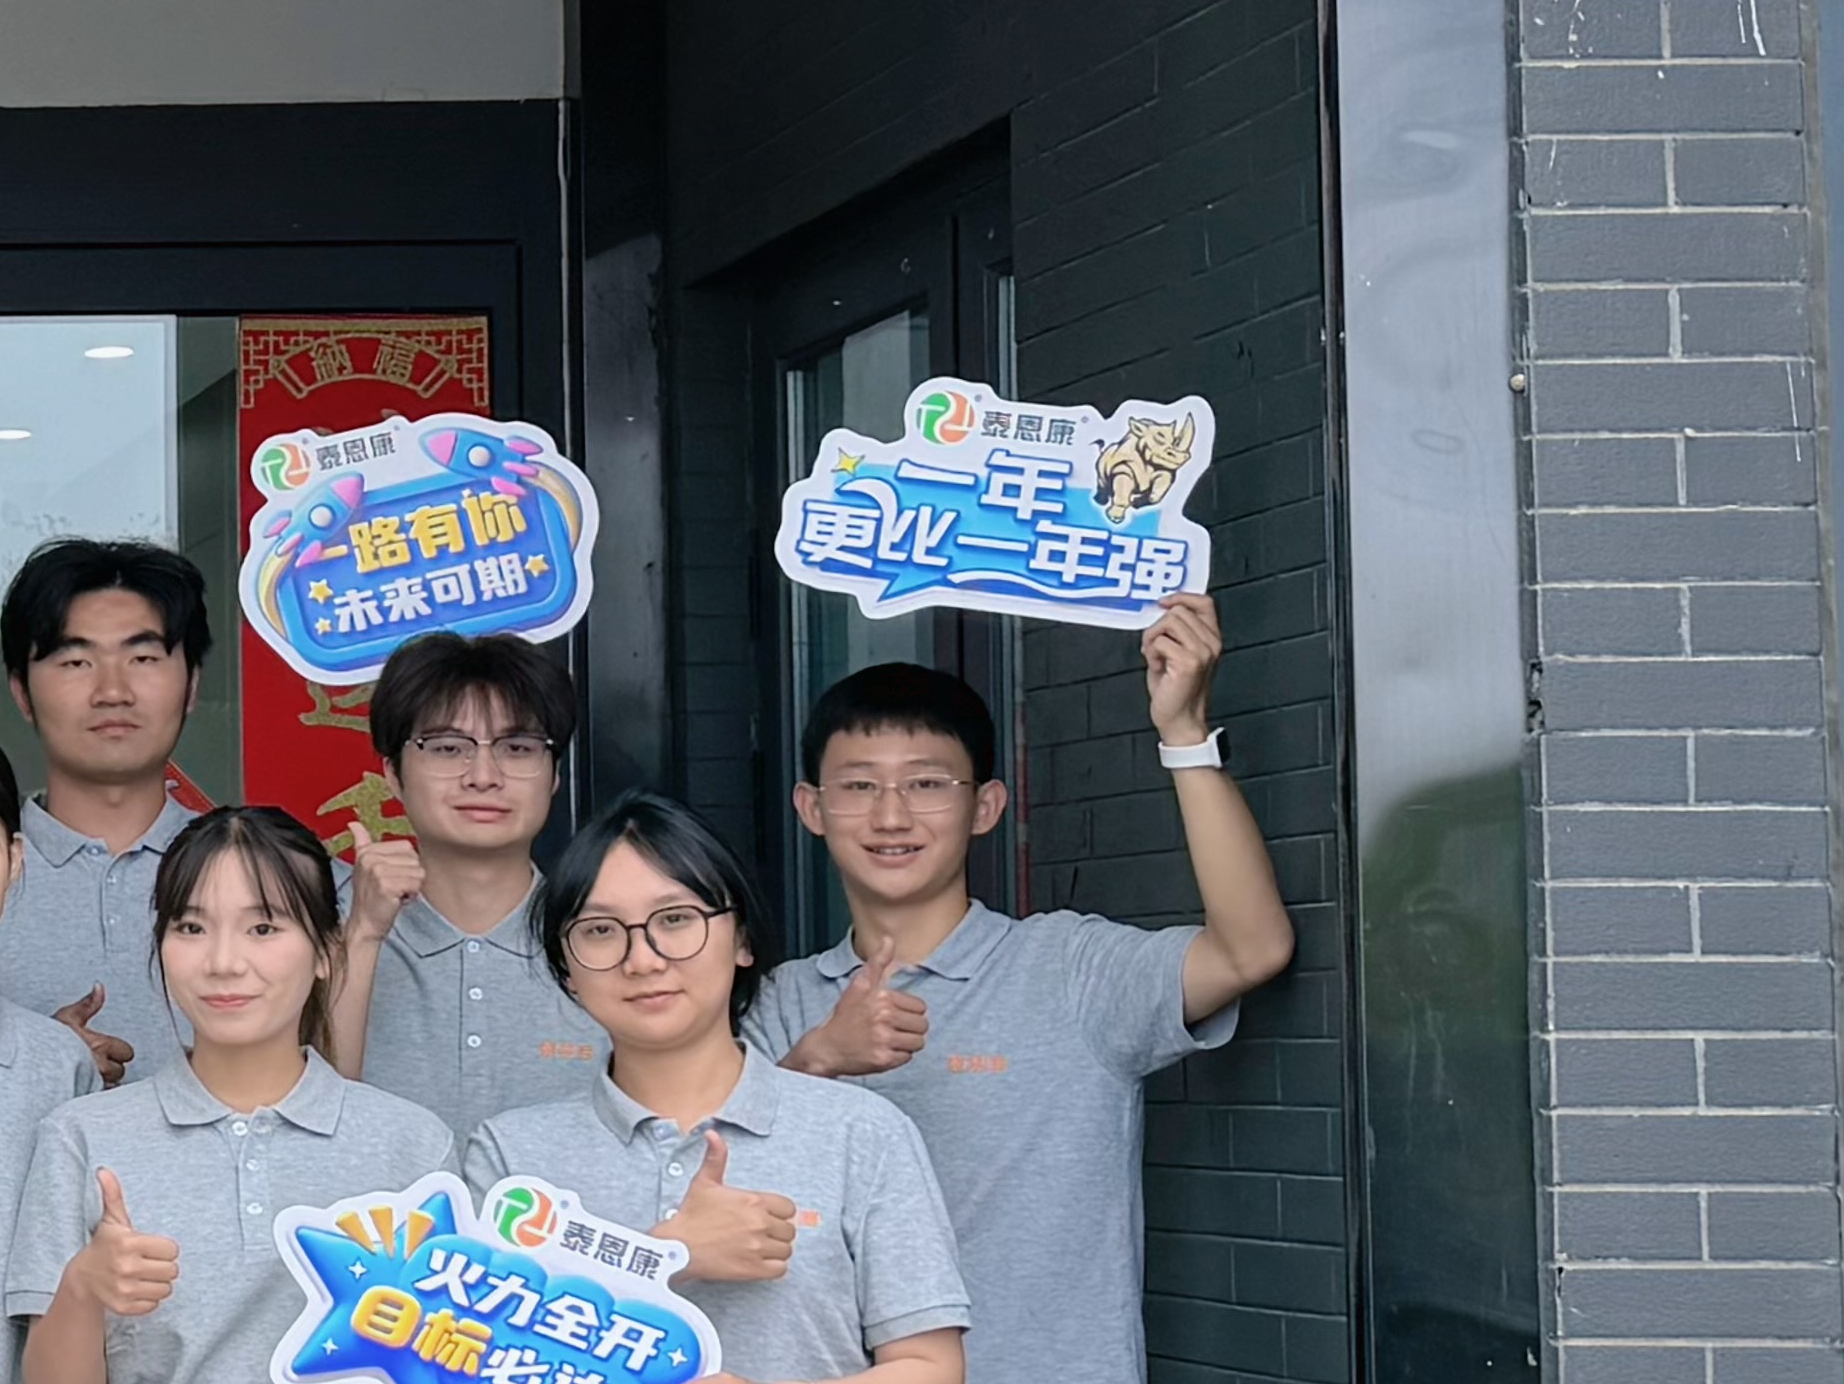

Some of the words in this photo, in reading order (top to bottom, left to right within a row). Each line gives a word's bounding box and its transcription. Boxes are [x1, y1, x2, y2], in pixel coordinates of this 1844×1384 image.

[315, 430, 397, 473] 泰恩康
[979, 410, 1078, 446] 泰恩康
[894, 448, 1074, 521] 一年
[320, 488, 528, 575] 一路有你
[796, 499, 1188, 602] 更比一年强
[332, 551, 528, 634] 未来可期
[558, 1219, 665, 1282] 泰恩康
[414, 1247, 667, 1373] 火力全开
